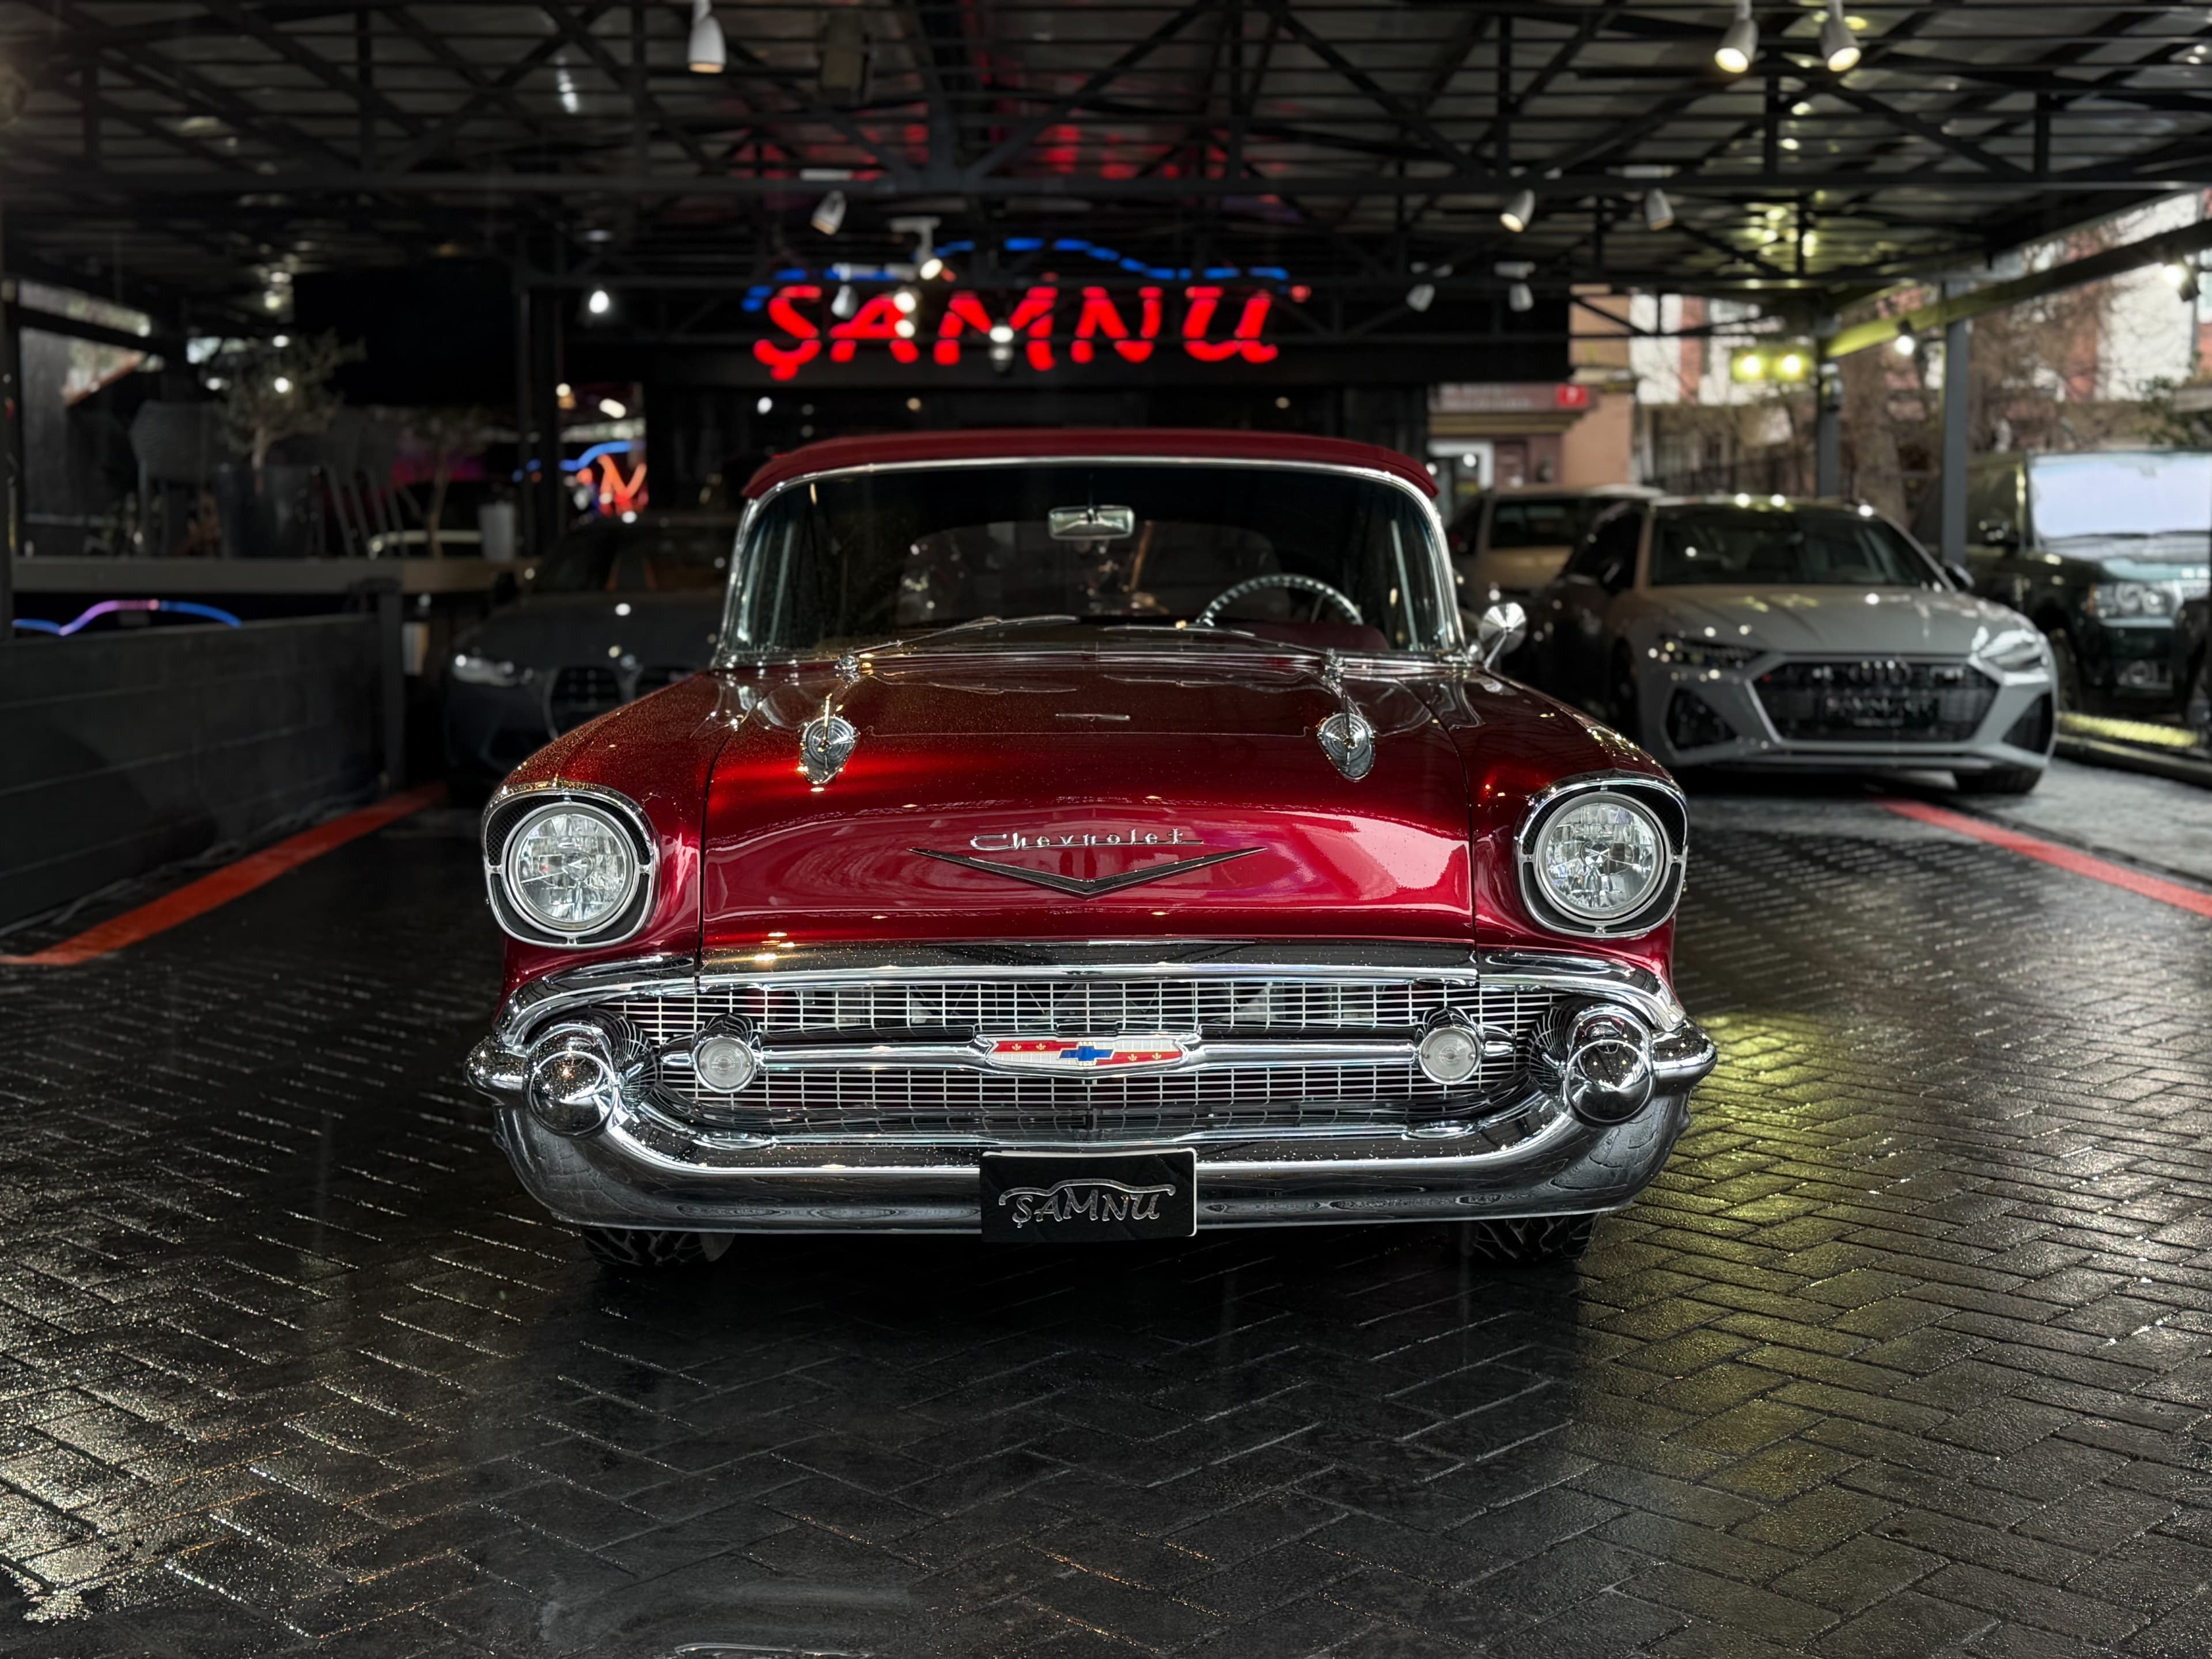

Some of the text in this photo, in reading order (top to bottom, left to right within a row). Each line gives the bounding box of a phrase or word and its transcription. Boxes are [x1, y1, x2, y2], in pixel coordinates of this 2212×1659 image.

[752, 285, 1279, 382] ŞAMNU
[969, 828, 1204, 851] Chevrolet
[1012, 1187, 1160, 1229] ŞAMNU
